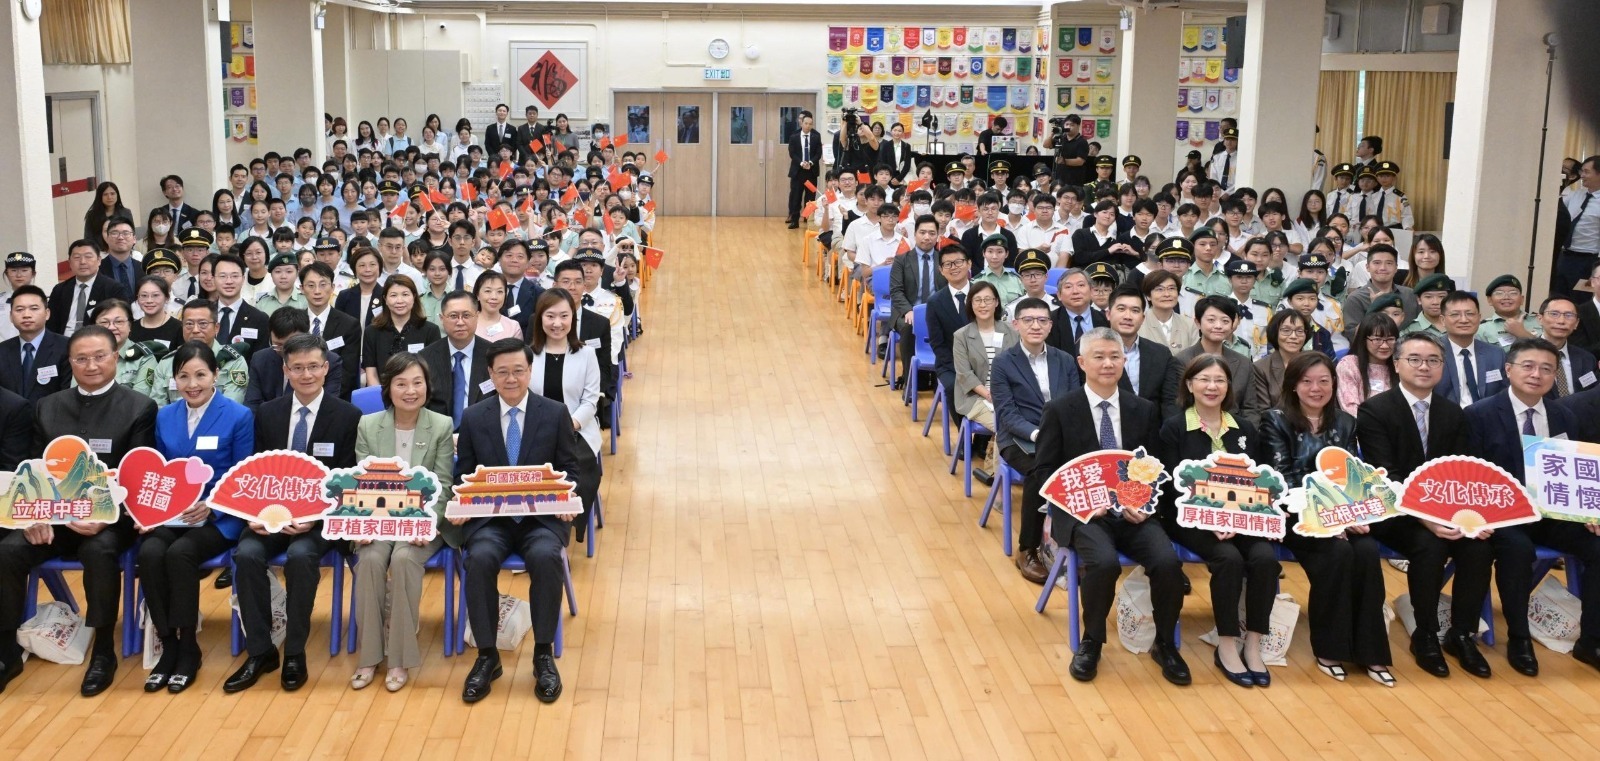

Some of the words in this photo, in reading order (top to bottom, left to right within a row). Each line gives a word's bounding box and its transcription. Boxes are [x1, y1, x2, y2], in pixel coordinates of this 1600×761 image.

[705, 69, 719, 79] EXIT
[486, 471, 542, 485] 向國旗敬禮
[1060, 462, 1105, 491] 我愛
[1542, 453, 1600, 482] 家國
[142, 471, 176, 496] 我愛
[232, 473, 321, 502] 文化傳承
[1419, 479, 1515, 508] 文化傳承
[1543, 481, 1600, 510] 情懷
[13, 500, 93, 519] 立根中華
[137, 489, 172, 513] 祖國
[1065, 487, 1111, 514] 祖國
[1319, 498, 1387, 528] 立根中華
[326, 518, 432, 537] 厚植家國情懷
[1182, 507, 1282, 534] 厚植家國情懷
